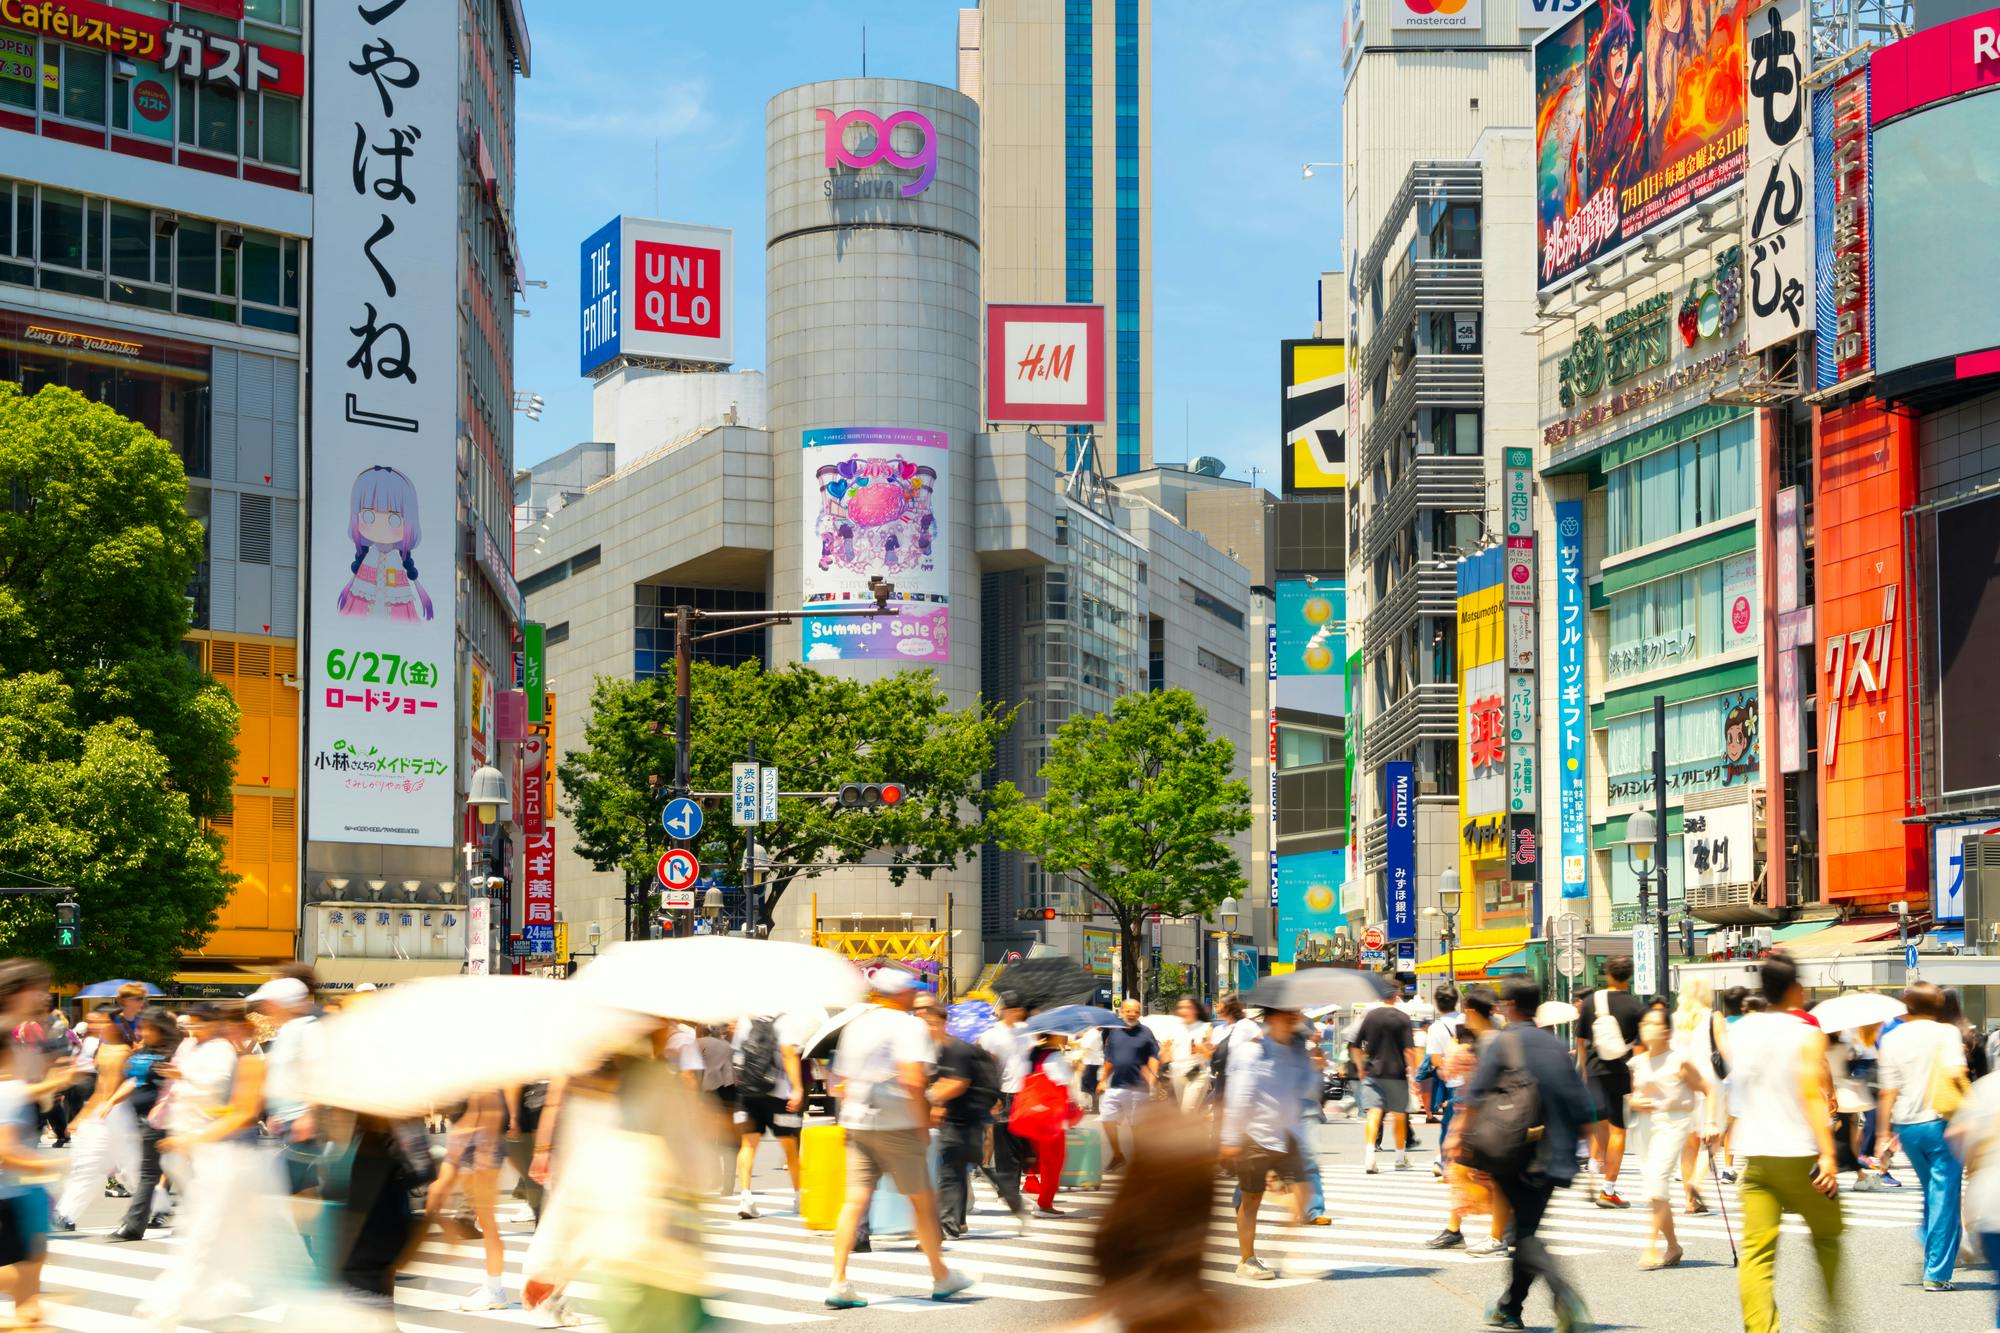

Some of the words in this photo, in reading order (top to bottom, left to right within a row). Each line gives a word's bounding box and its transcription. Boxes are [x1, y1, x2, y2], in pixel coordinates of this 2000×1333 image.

[1406, 17, 1466, 25] mastercard
[1, 0, 154, 54] Caféレストラン
[164, 27, 279, 91] ガスト
[1974, 27, 2000, 64] R
[816, 109, 938, 198] 109
[1750, 7, 1804, 328] もんじゃ
[824, 180, 895, 199] SHIBUYA
[346, 0, 422, 433] やばくね』
[590, 242, 611, 299] THE
[645, 252, 705, 289] UNI
[583, 290, 618, 356] PRIME
[644, 290, 711, 327] QLO
[1017, 343, 1075, 383] H&M
[1460, 343, 1472, 351] 7F
[1511, 471, 1529, 522] 渋谷西村
[1514, 538, 1527, 548] 4F
[811, 622, 882, 638] Summer
[890, 620, 930, 636] Sale
[1461, 603, 1498, 624] Matsumoto
[1560, 545, 1582, 751] サマーフルーツギフト
[326, 648, 438, 688] 6/27(金)
[528, 657, 539, 687] レイク
[326, 688, 438, 715] ロードショー
[1522, 688, 1532, 723] フルーツ
[1470, 697, 1504, 769] 薬
[314, 751, 448, 776] 小林さんちのメイドラゴン
[1513, 762, 1521, 797] フルーツ
[1523, 757, 1532, 794] 渋谷西村
[526, 776, 541, 814] アコム
[744, 768, 755, 820] 渋谷駅前
[766, 770, 774, 819] スクランブル式
[1396, 775, 1408, 828] MIZUHO
[1517, 828, 1536, 865] HUB
[528, 830, 553, 921] スギ薬局
[1395, 867, 1407, 924] みずほ銀行
[329, 911, 457, 928] 渋谷駅前ビル
[1636, 929, 1647, 983] 文化村通り
